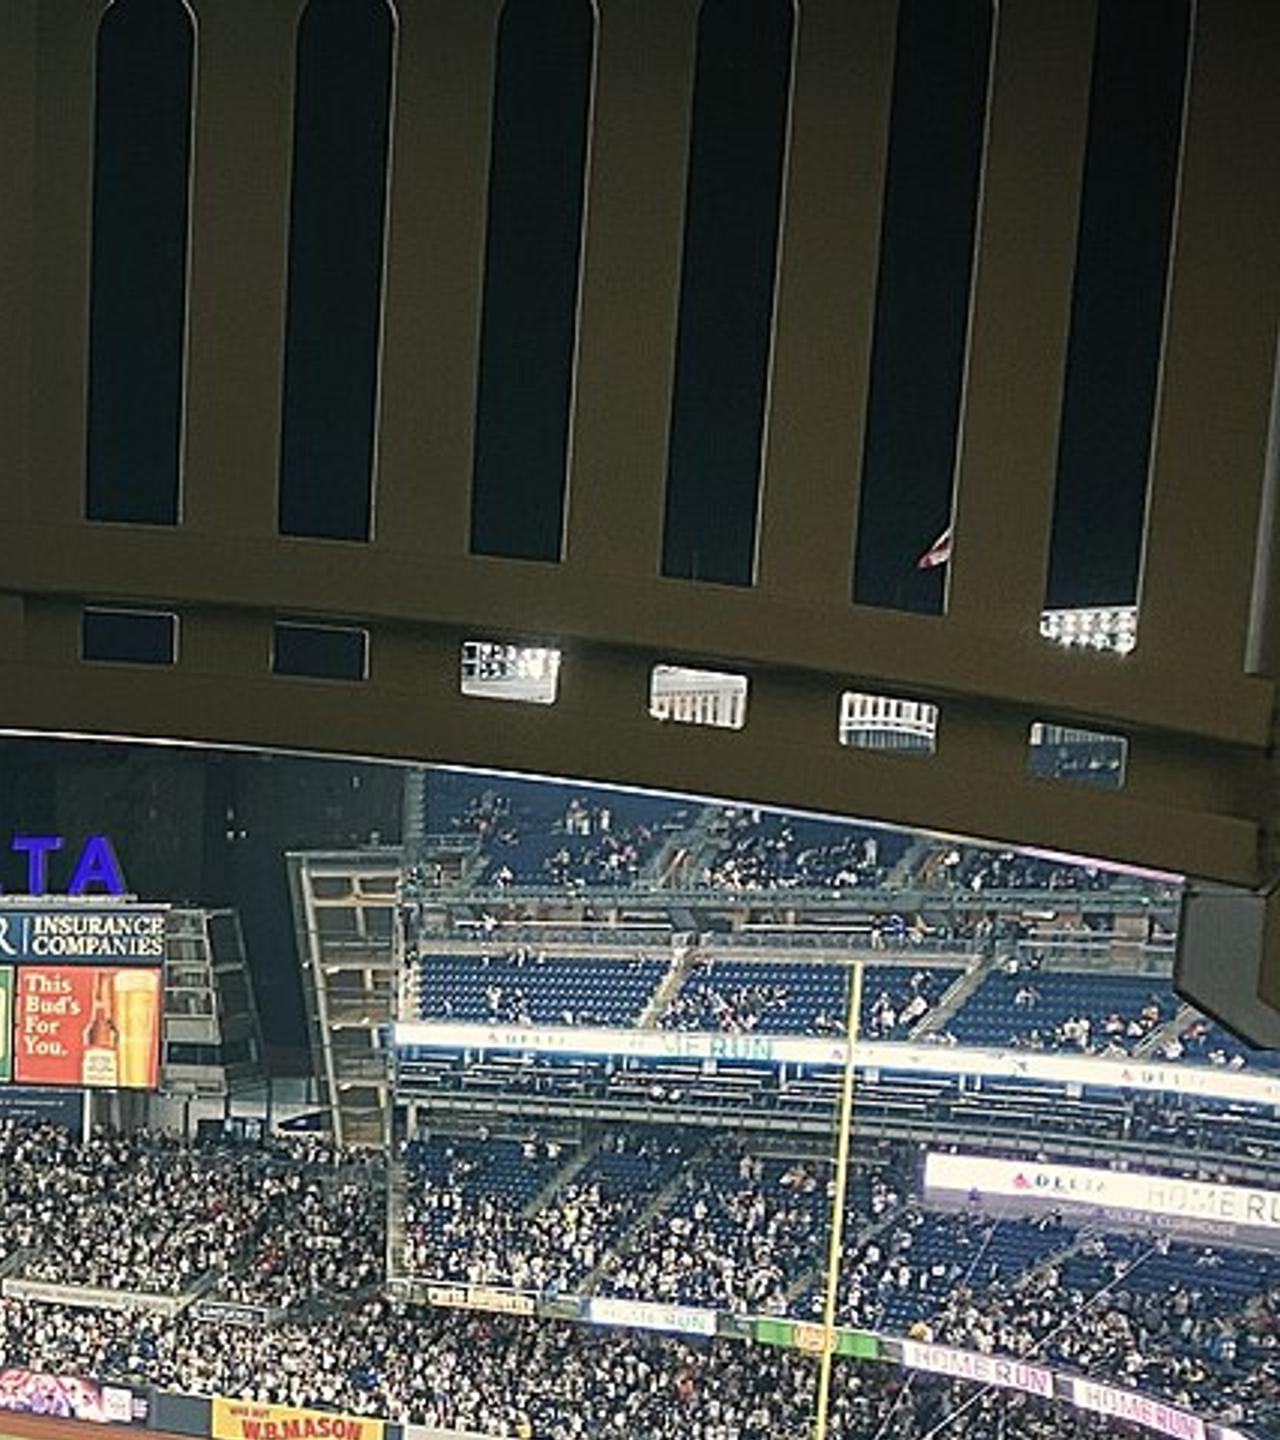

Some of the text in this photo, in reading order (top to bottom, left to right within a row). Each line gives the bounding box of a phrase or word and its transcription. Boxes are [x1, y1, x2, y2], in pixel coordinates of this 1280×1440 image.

[32, 915, 165, 936] INSURANCE
[32, 936, 164, 955] COMPANIES
[24, 973, 72, 994] This
[24, 994, 81, 1015] Bud's
[24, 1015, 60, 1035] For
[24, 1035, 69, 1057] You.
[994, 1364, 1050, 1392] RUN
